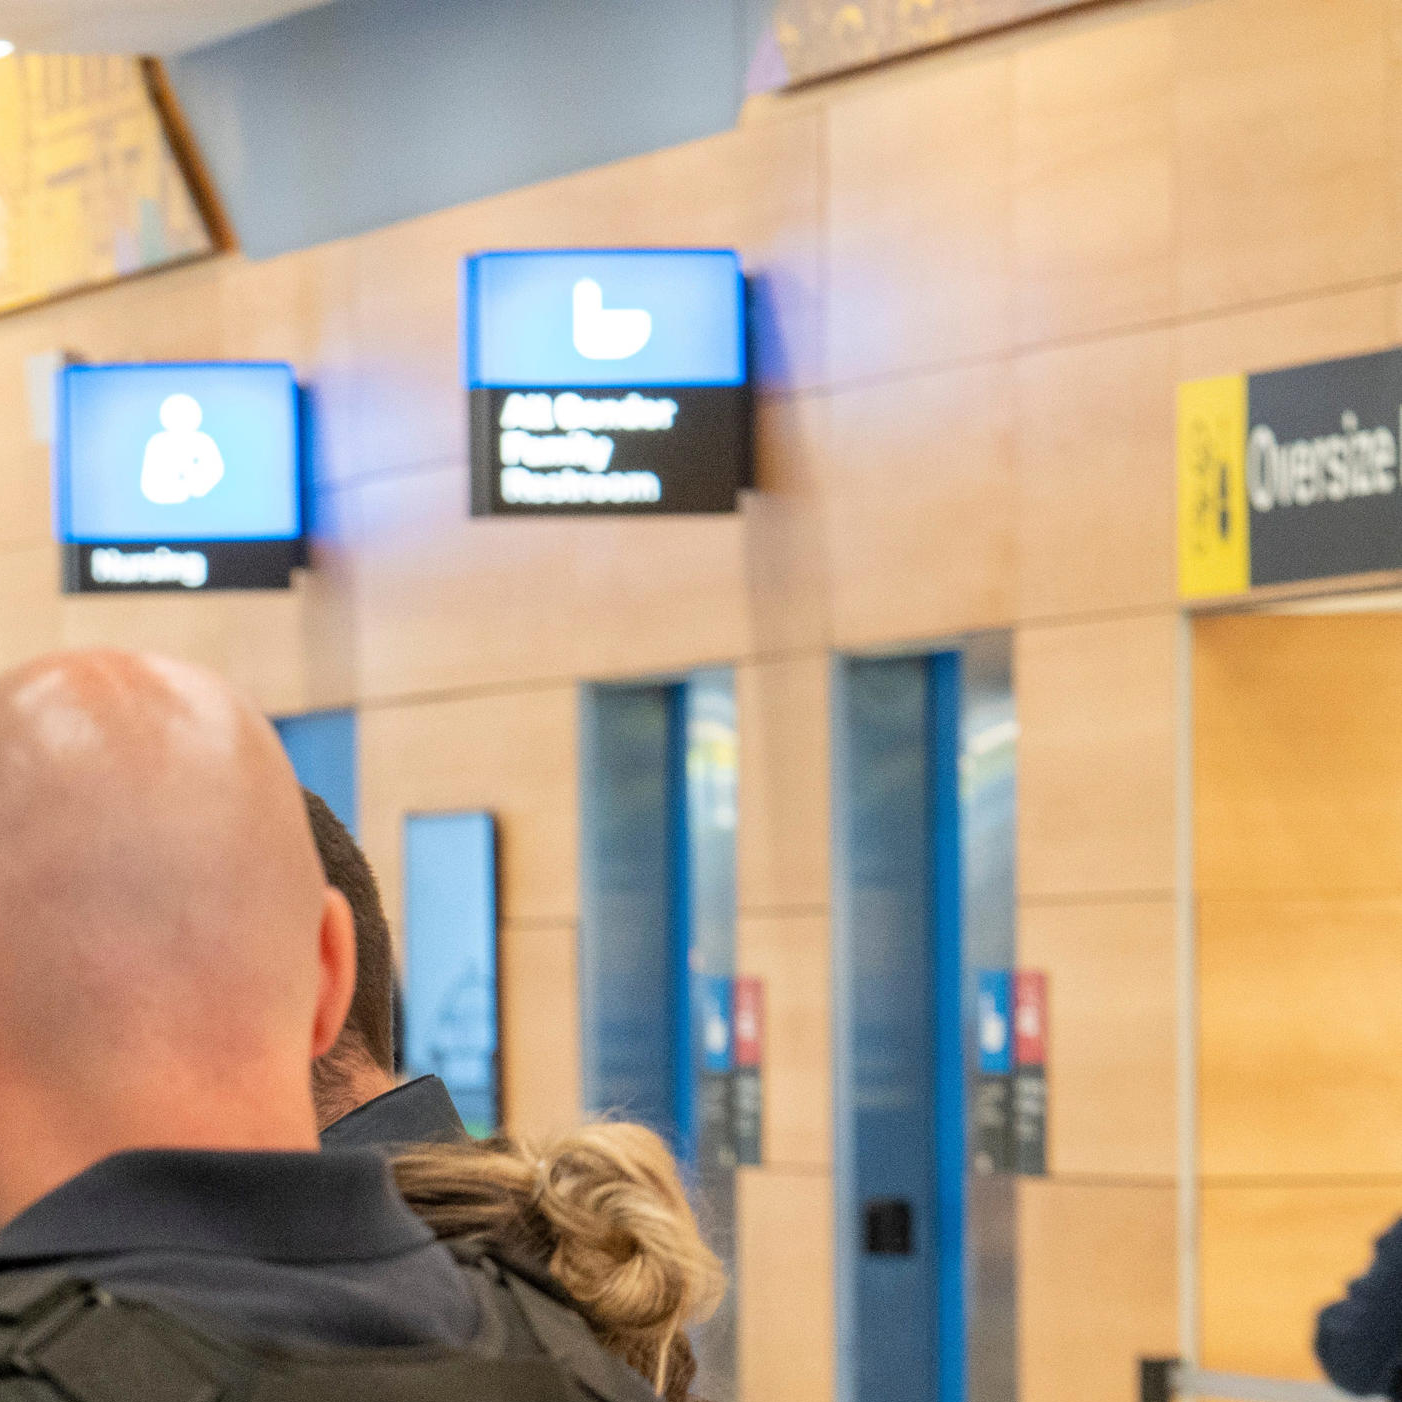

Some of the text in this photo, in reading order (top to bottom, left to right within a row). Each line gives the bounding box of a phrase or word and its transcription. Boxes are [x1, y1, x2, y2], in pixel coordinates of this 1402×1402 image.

[499, 392, 678, 431] All Gender
[500, 429, 614, 472] Family
[1247, 409, 1397, 513] Oversize
[501, 466, 661, 504] Restroom
